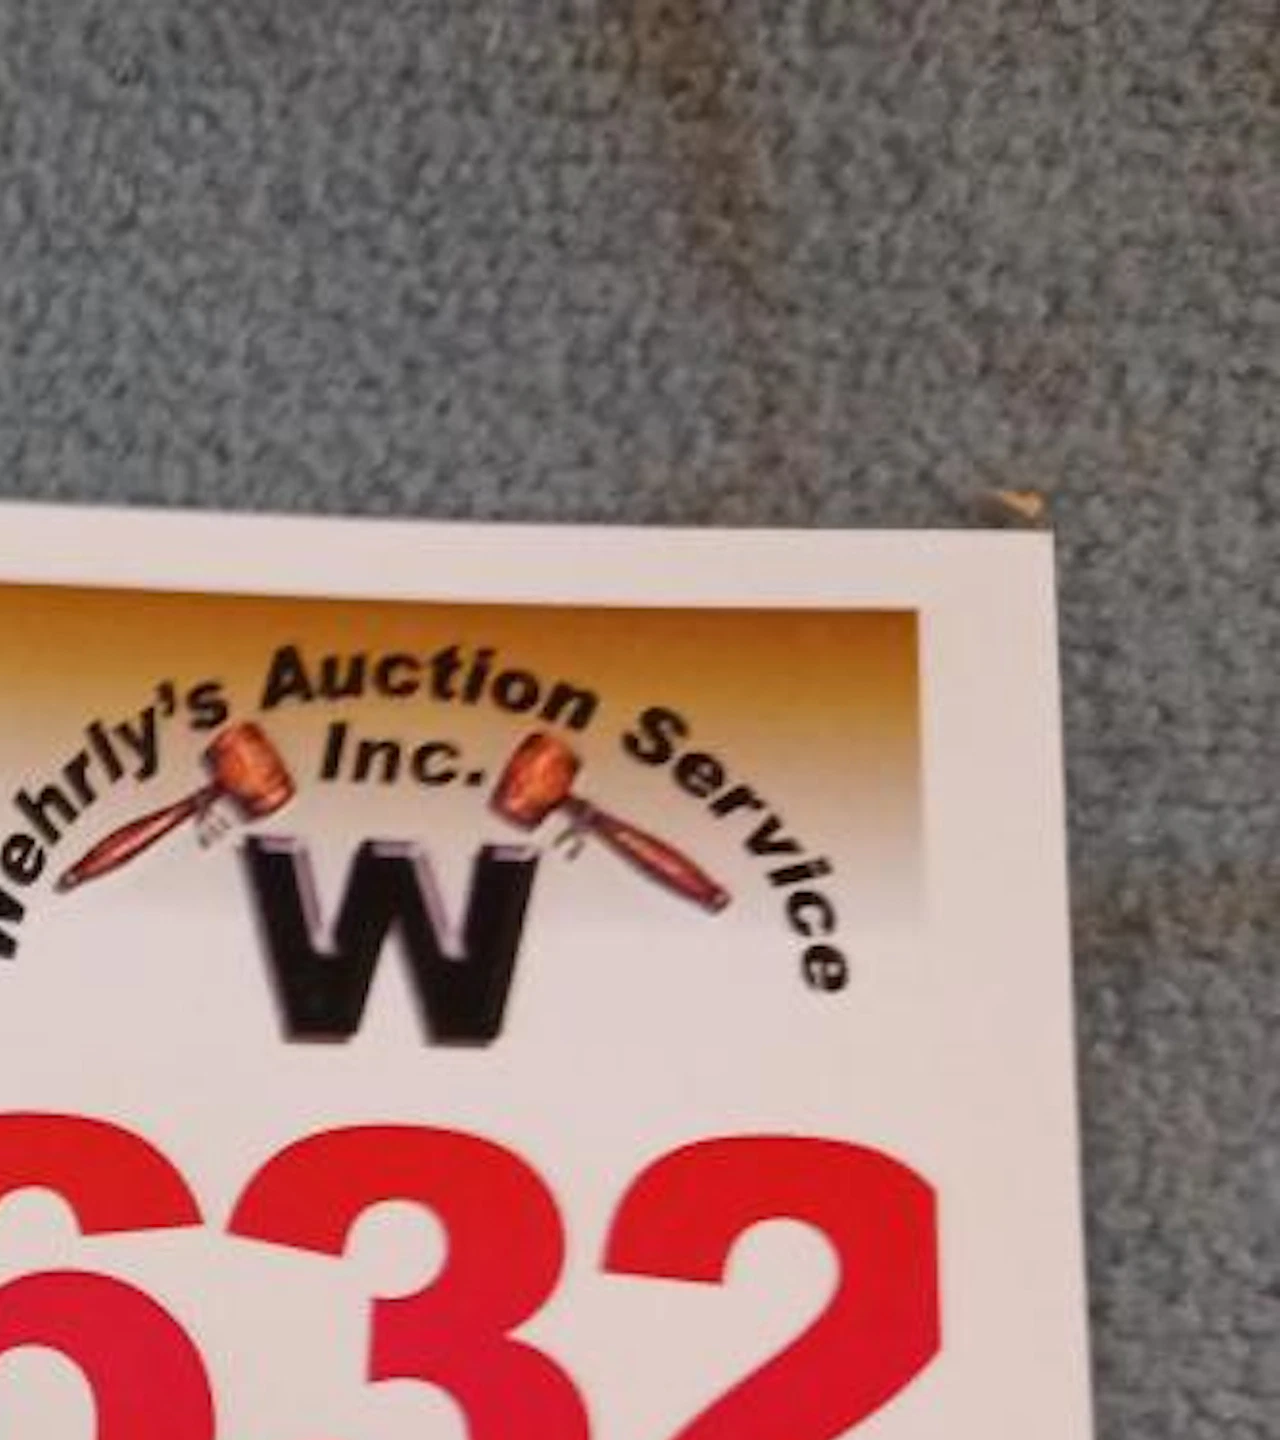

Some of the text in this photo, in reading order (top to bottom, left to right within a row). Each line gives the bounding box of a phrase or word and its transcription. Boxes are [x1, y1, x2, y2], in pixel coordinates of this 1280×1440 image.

[260, 643, 600, 730] Auction
[620, 706, 851, 996] Service
[318, 722, 487, 788] Inc.
[244, 834, 540, 1048] W
